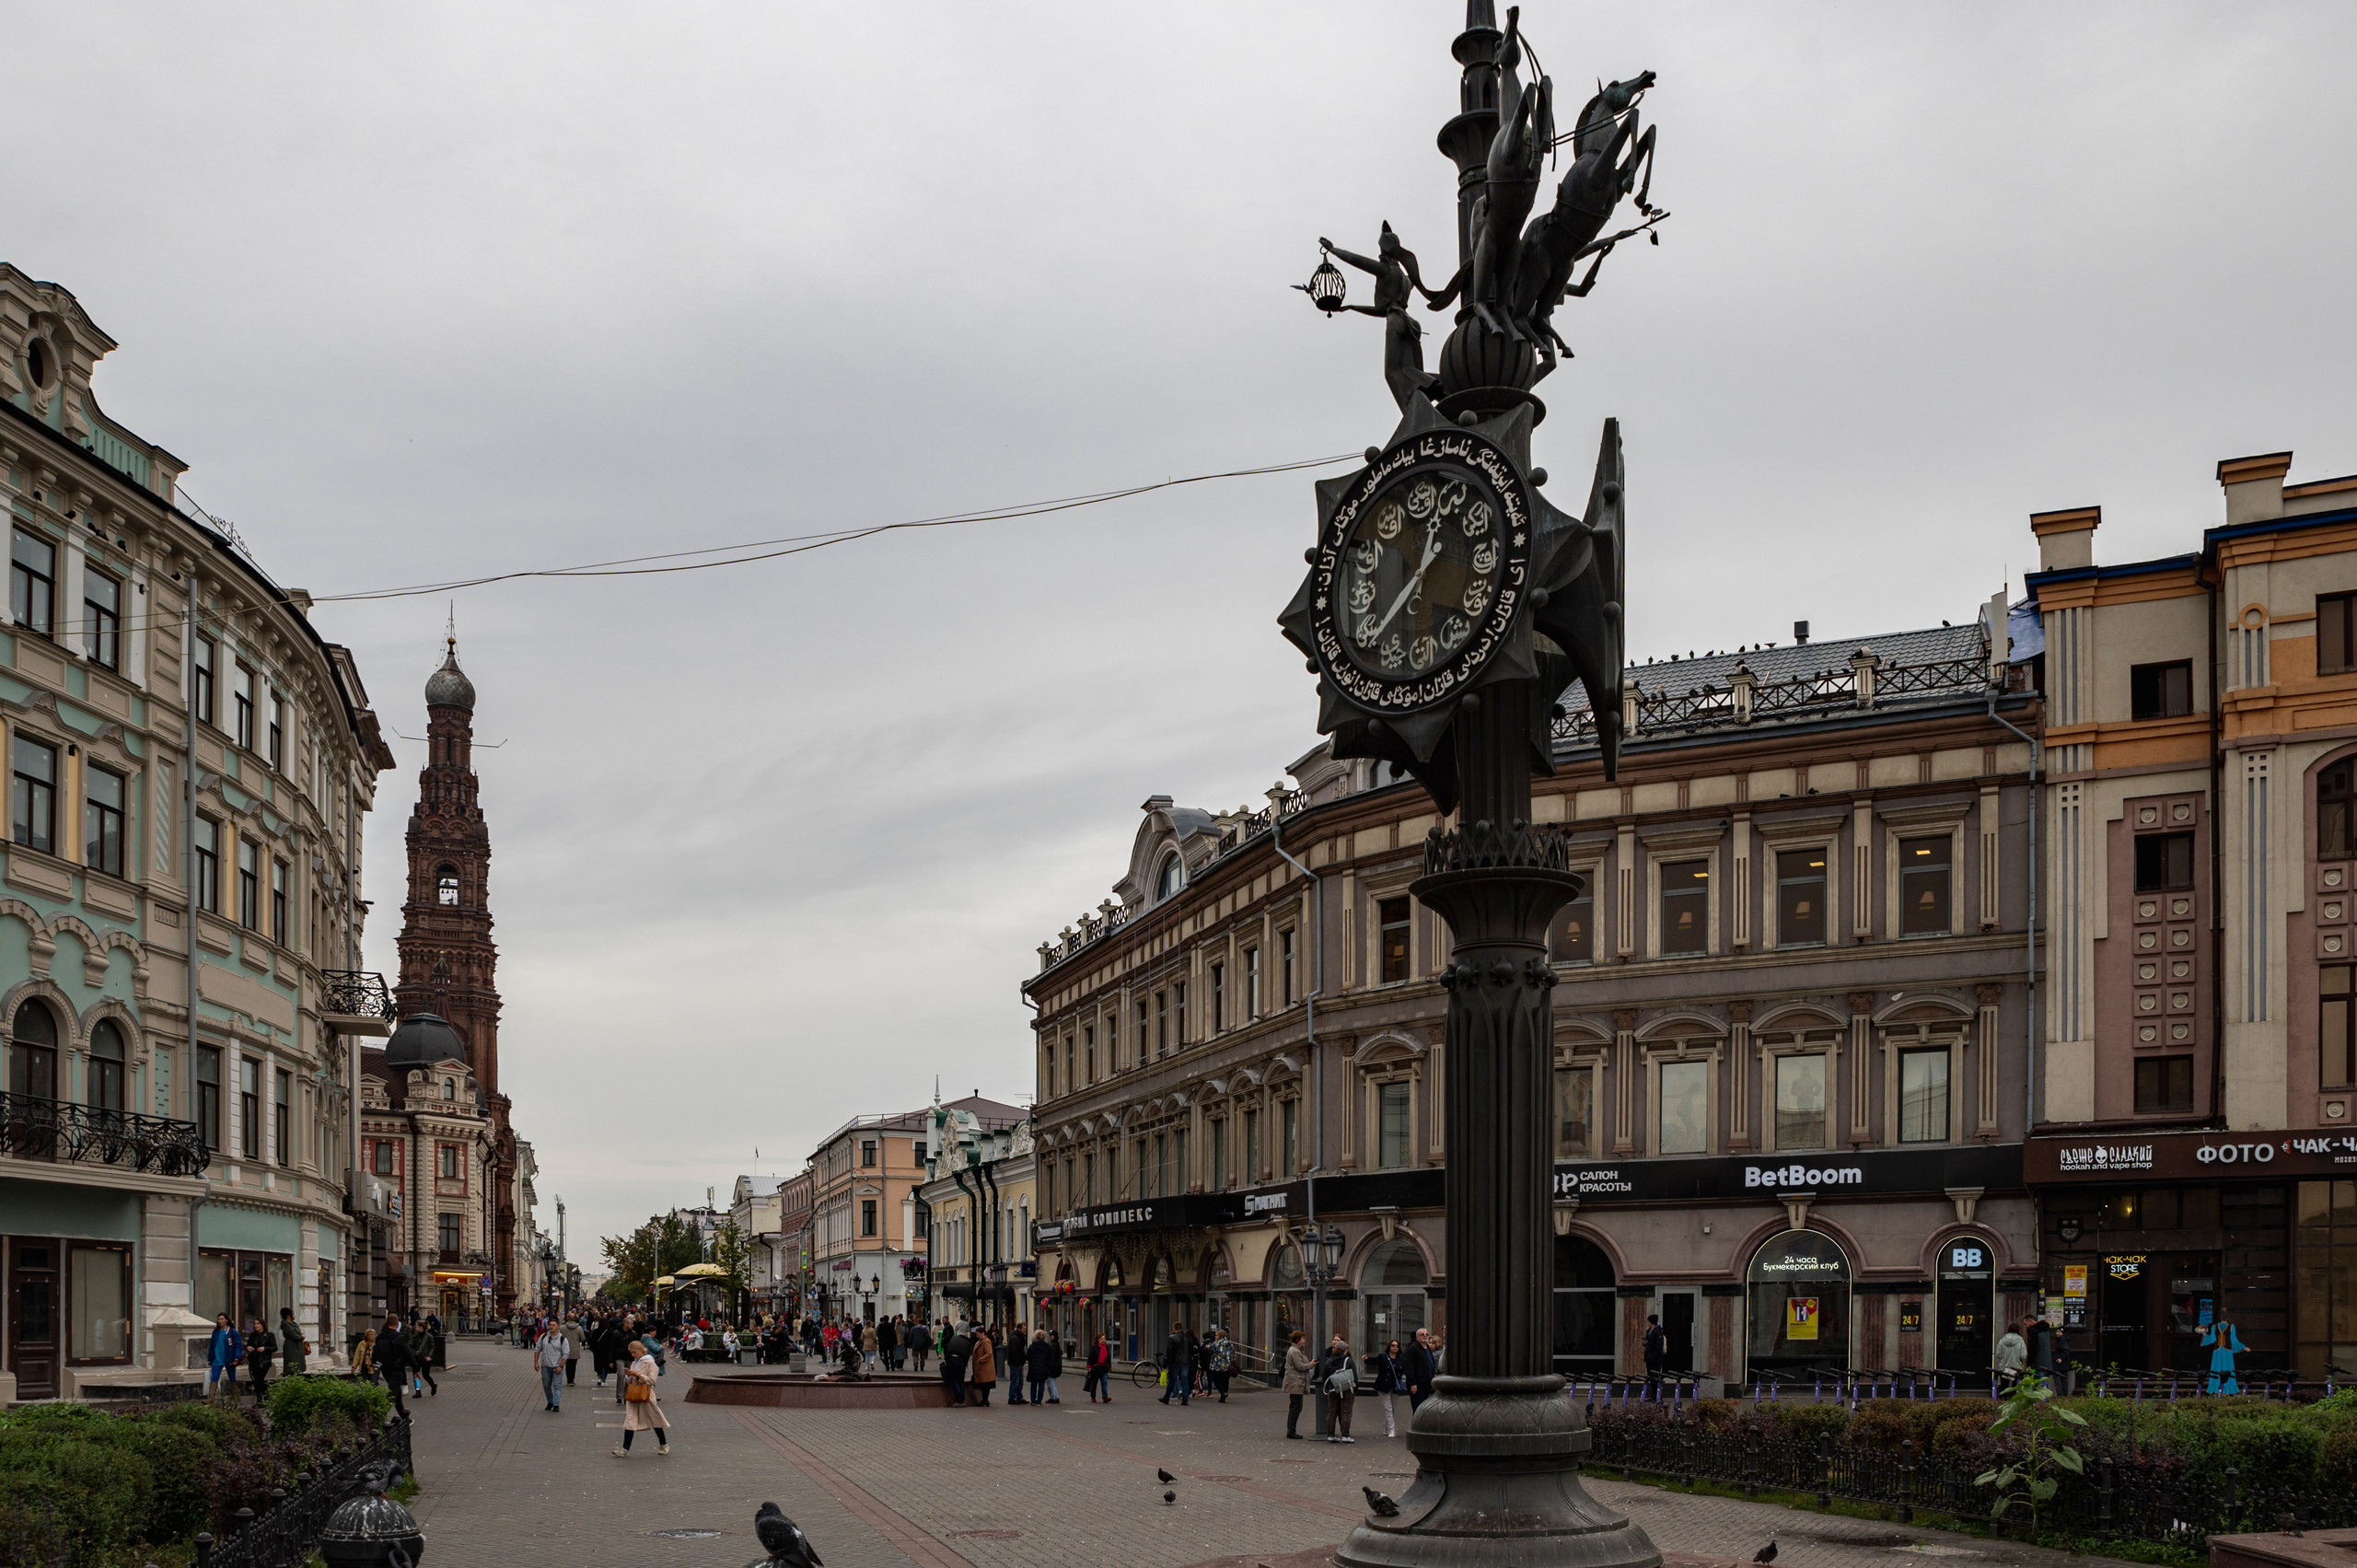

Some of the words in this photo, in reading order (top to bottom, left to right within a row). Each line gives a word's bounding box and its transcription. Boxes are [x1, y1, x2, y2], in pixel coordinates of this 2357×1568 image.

[2293, 1137, 2357, 1154] ЧАК-Ч
[2196, 1143, 2274, 1164] ФОТО
[2131, 1161, 2153, 1169] shop
[1580, 1170, 1619, 1180] САЛОН
[1745, 1165, 1862, 1188] BetBoom
[1579, 1182, 1631, 1192] КРАСОТЫ
[1255, 1192, 1288, 1211] МАГНИТ
[1093, 1207, 1153, 1226] КОМПЛЕКС
[1952, 1248, 1982, 1267] BB
[1763, 1261, 1818, 1271] Букмекерский
[1819, 1261, 1840, 1271] клуб
[2110, 1264, 2139, 1273] STORE
[1902, 1314, 1920, 1326] 24/7
[1956, 1314, 1973, 1326] 24/7
